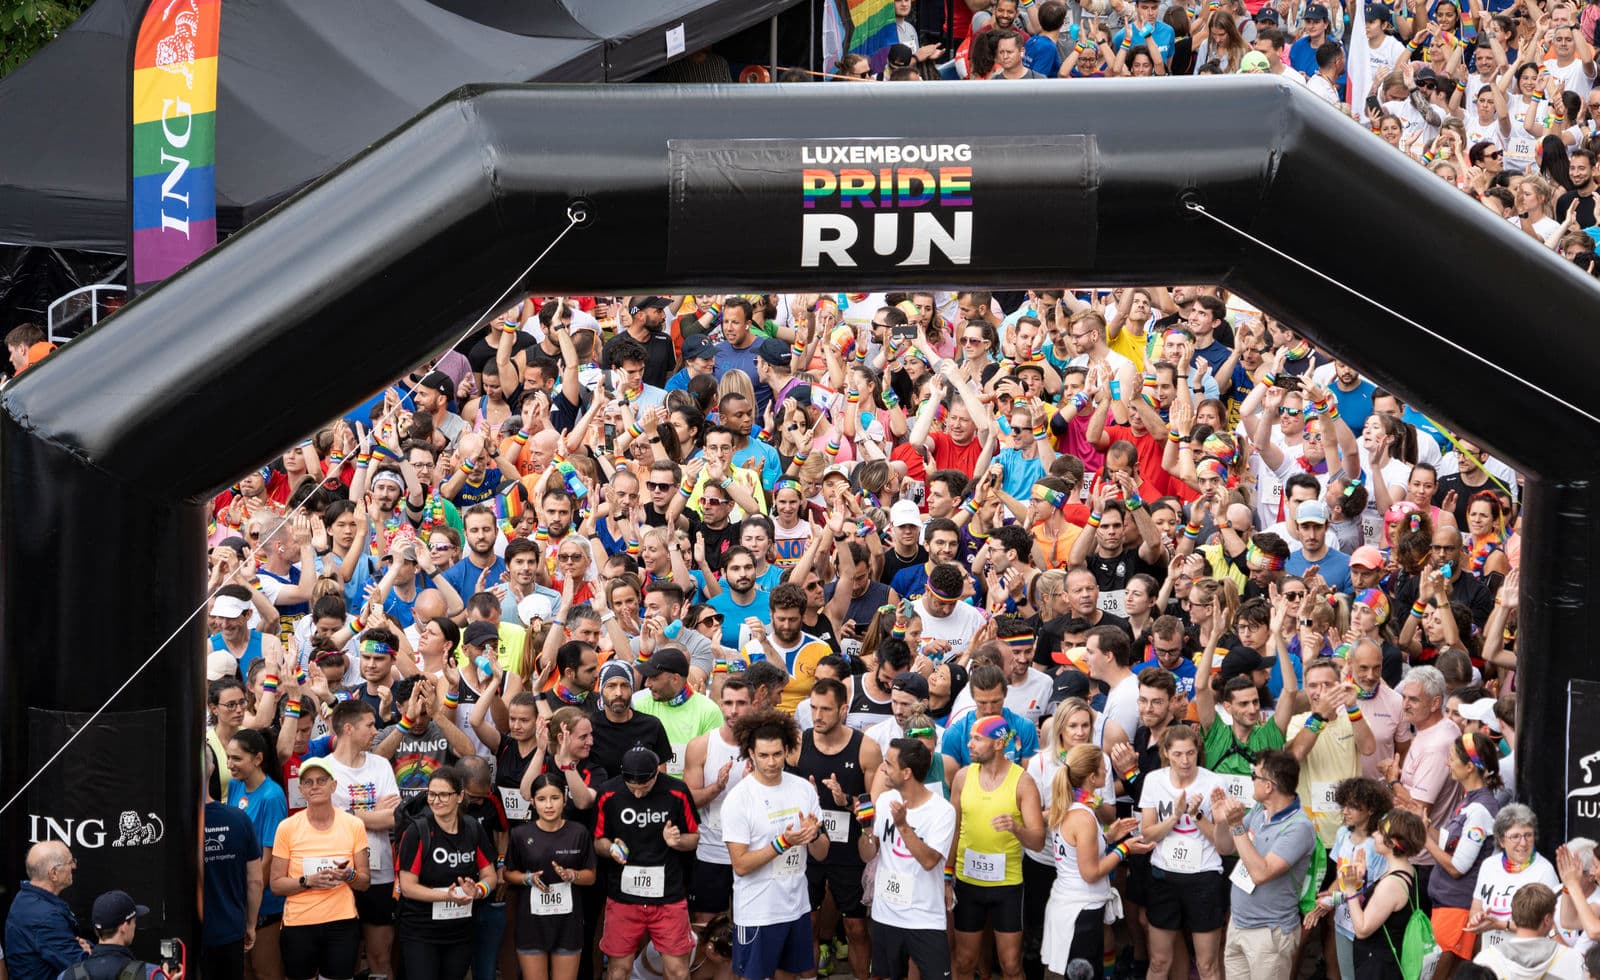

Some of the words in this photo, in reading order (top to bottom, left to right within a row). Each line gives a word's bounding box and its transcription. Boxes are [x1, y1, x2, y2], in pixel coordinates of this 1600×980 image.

[801, 144, 972, 165] LUXEMBOURG
[1515, 145, 1529, 154] 1125
[161, 95, 193, 241] ING
[802, 166, 973, 209] PRIDE
[801, 211, 973, 268] RUN
[1103, 600, 1118, 611] 528
[947, 638, 963, 647] SBC
[846, 647, 861, 657] 675
[397, 738, 448, 753] UNNING
[1228, 785, 1243, 797] 491
[1325, 790, 1337, 802] 81
[504, 796, 519, 809] 631
[1577, 800, 1600, 819] LU
[620, 808, 669, 828] Ogier
[823, 818, 837, 832] 90
[28, 814, 107, 848] ING
[205, 826, 230, 835] unners
[432, 847, 477, 868] Ogier
[785, 853, 800, 868] 472
[1172, 847, 1188, 860] 397
[971, 859, 995, 872] 1533
[633, 876, 652, 888] 1178
[885, 880, 901, 894] 288
[539, 892, 562, 906] 1046
